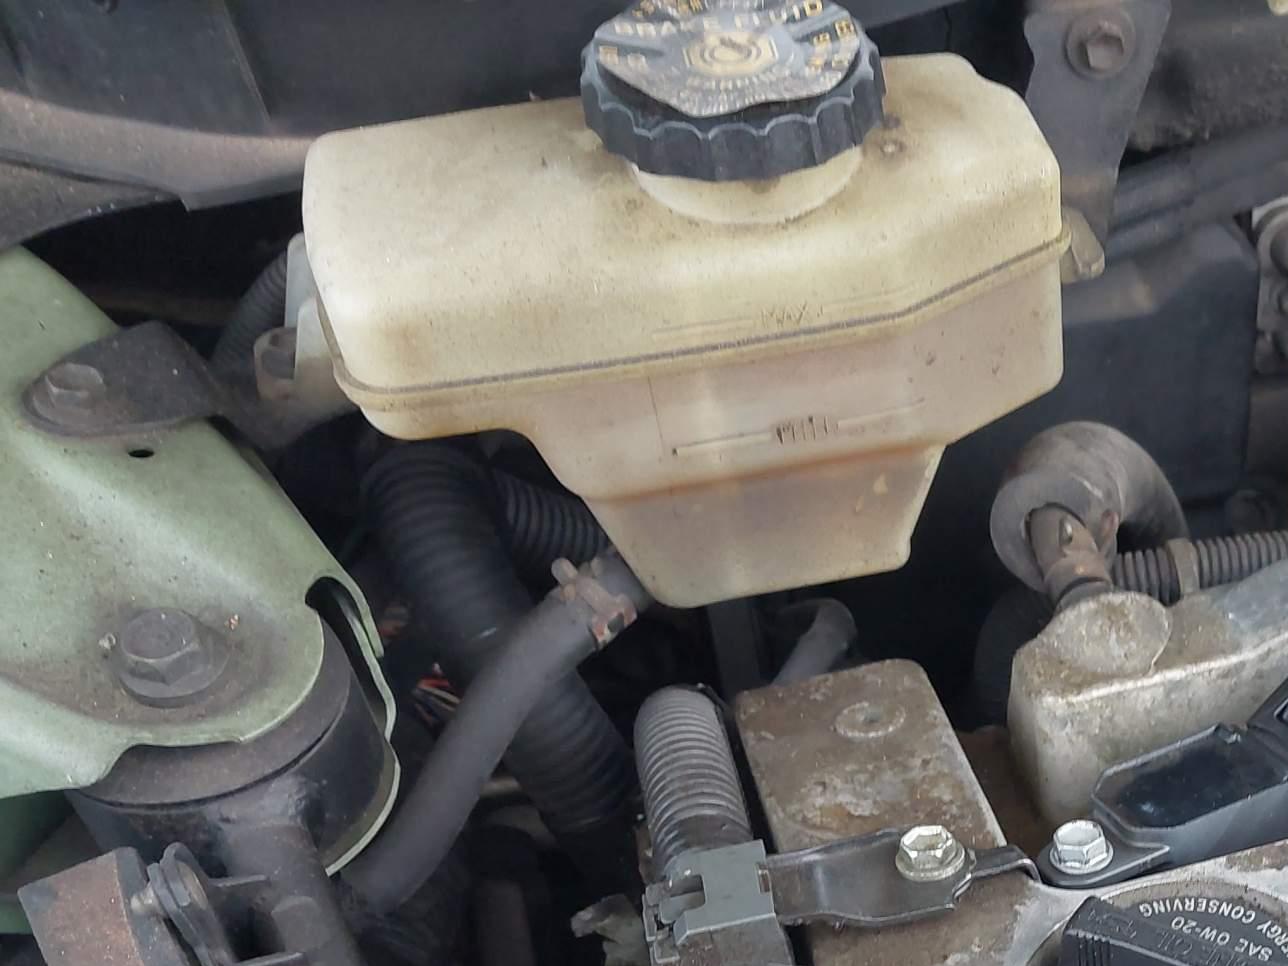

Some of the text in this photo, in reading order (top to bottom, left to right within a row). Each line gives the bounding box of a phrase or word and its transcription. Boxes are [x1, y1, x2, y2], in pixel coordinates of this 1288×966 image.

[735, 0, 823, 29] FLUID
[1139, 897, 1256, 925] CONSERVING
[1234, 937, 1273, 962] SAE
